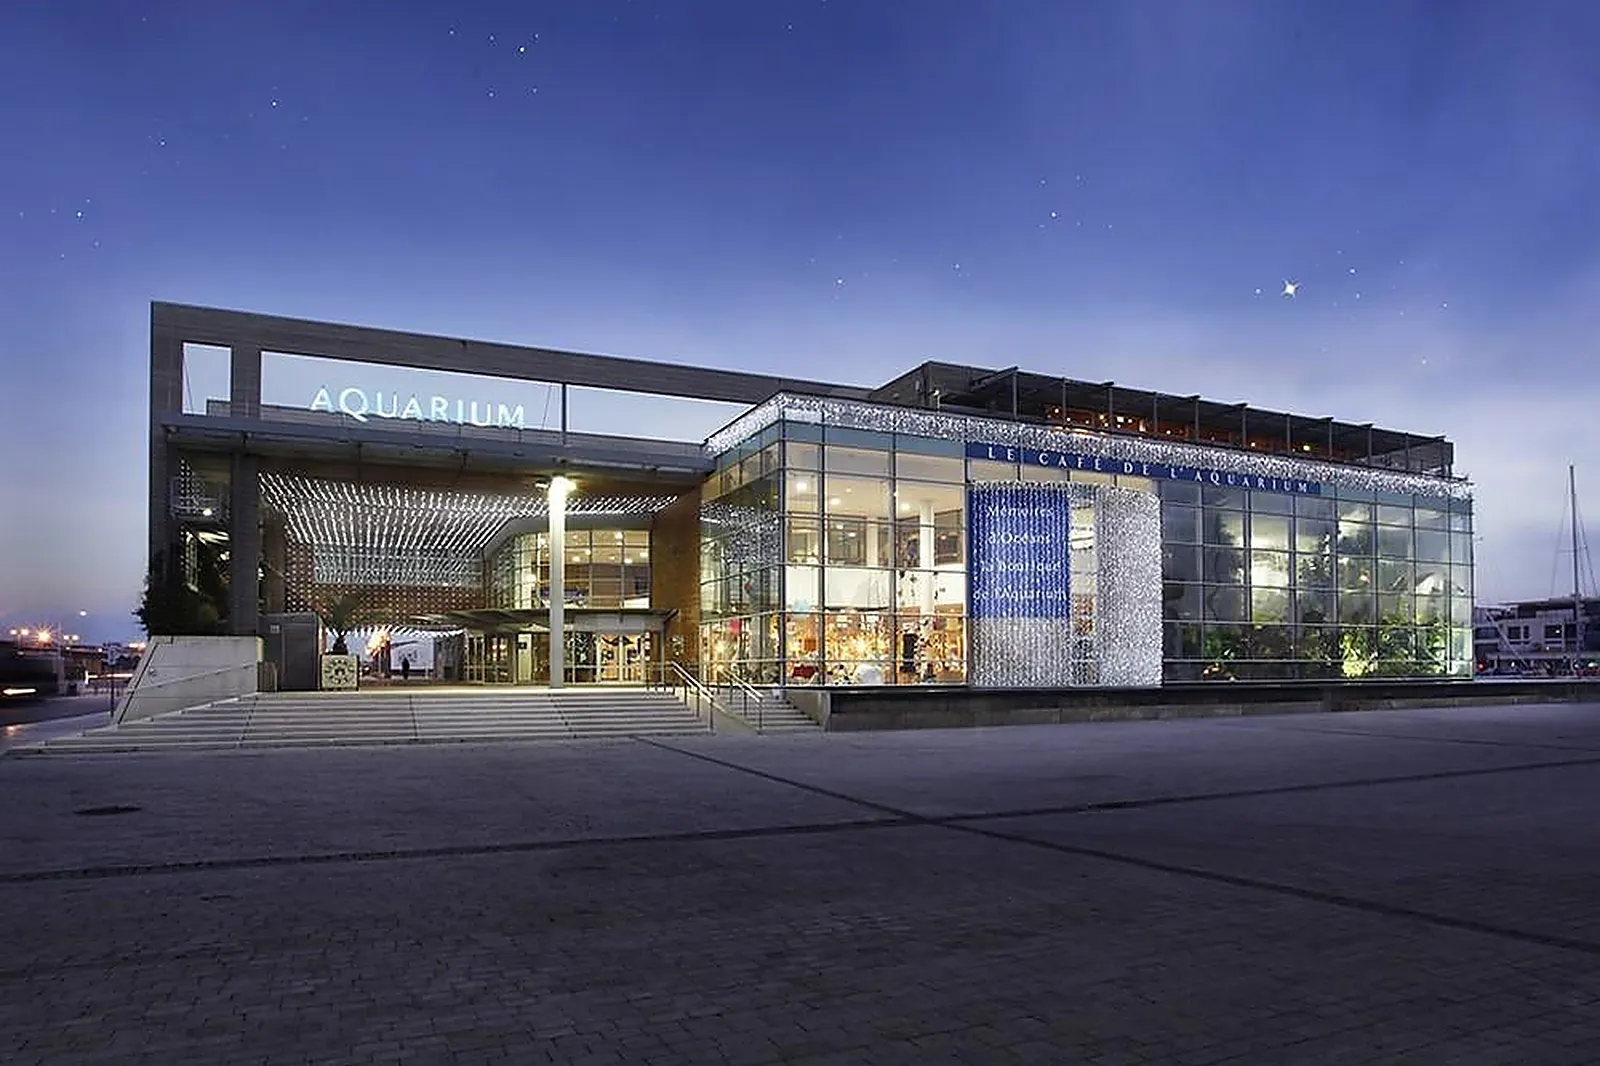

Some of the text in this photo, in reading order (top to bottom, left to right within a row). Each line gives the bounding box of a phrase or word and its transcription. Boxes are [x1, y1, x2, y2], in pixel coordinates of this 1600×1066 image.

[311, 387, 524, 429] AQUARIUM
[988, 446, 1308, 492] LE CAFÉ DE L'AQUARIUM
